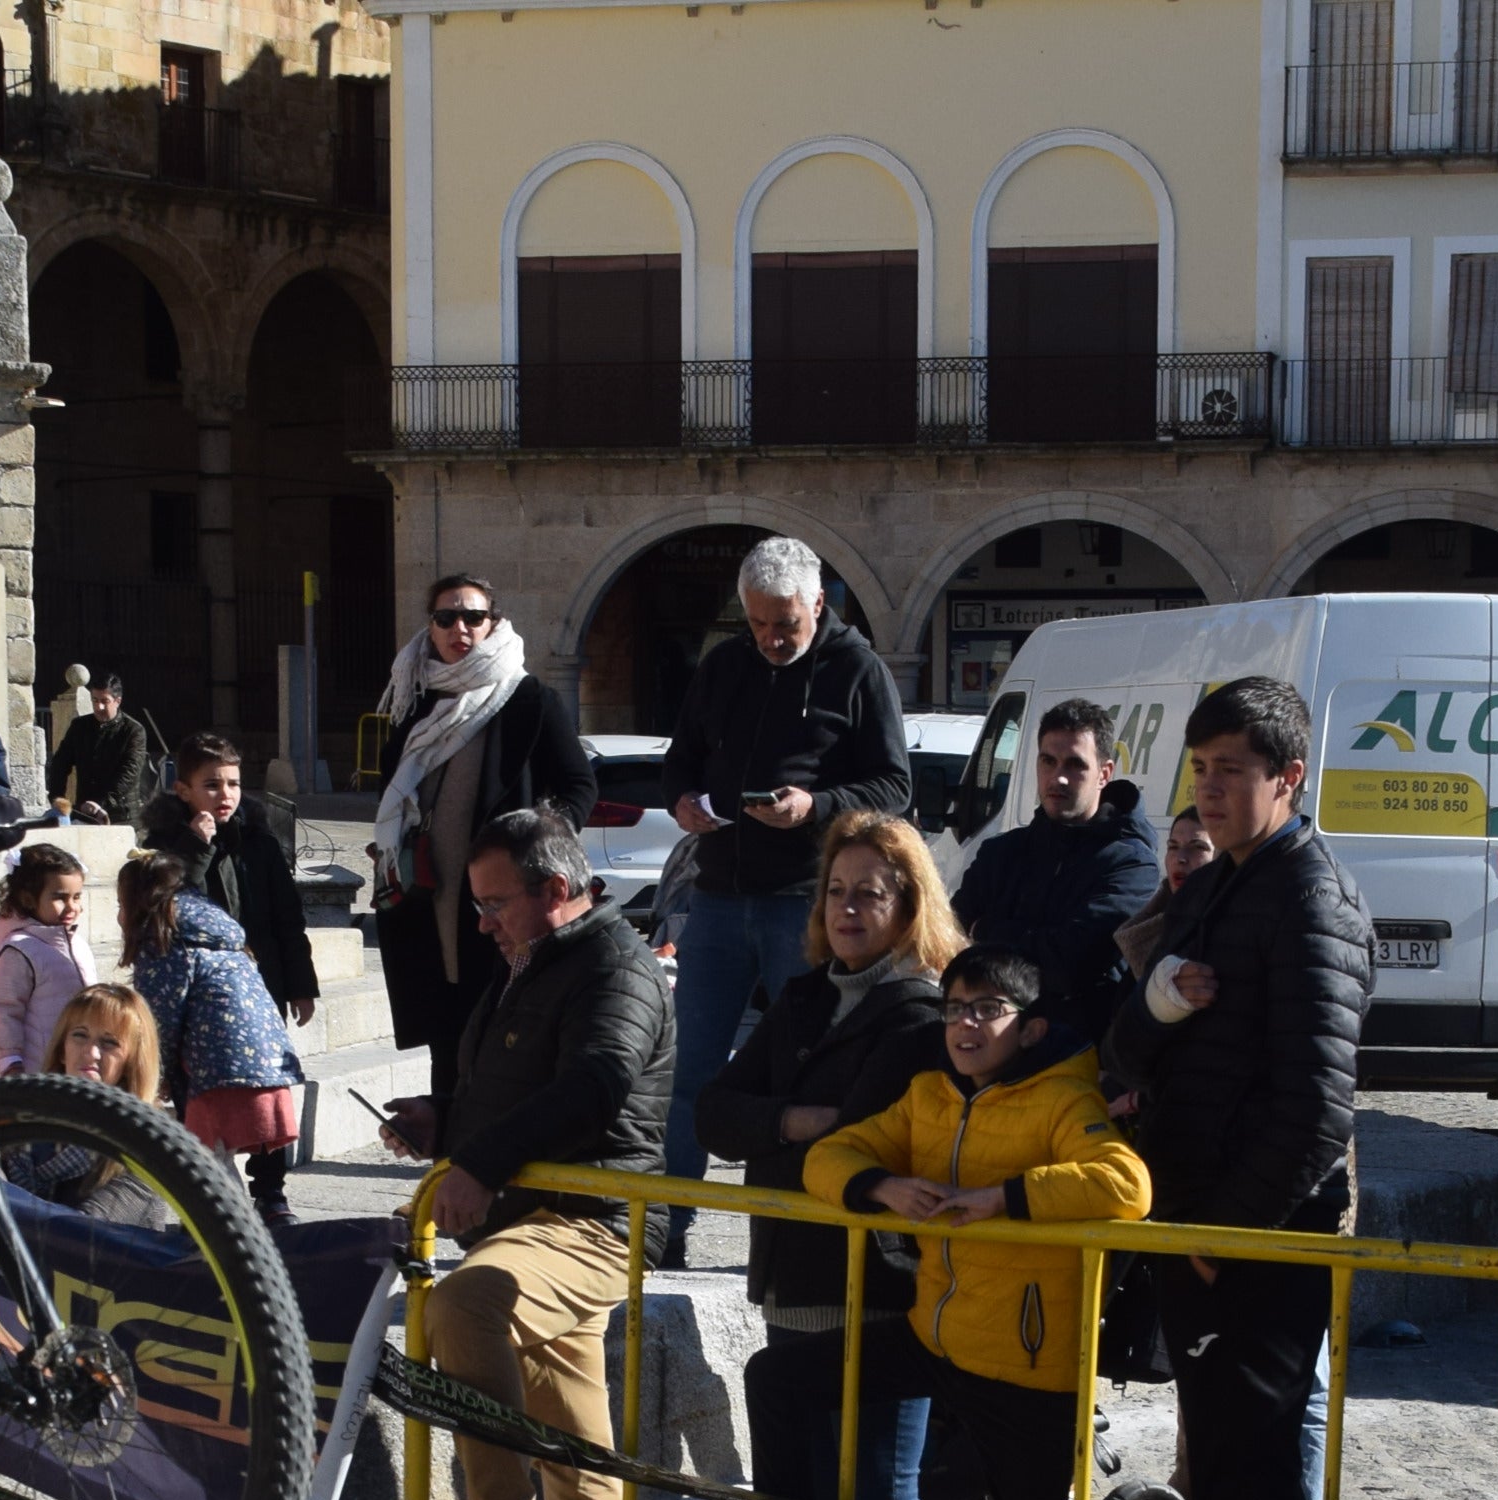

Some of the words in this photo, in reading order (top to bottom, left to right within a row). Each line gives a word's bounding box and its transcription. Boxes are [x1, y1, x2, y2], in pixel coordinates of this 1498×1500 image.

[1382, 779, 1408, 793] 603
[1412, 780, 1428, 793] 80
[1432, 781, 1449, 794] 20
[1452, 782, 1469, 795] 90
[1382, 797, 1409, 811] 924
[1413, 799, 1439, 812] 308
[1442, 799, 1469, 813] 850
[1397, 943, 1433, 961] LRY
